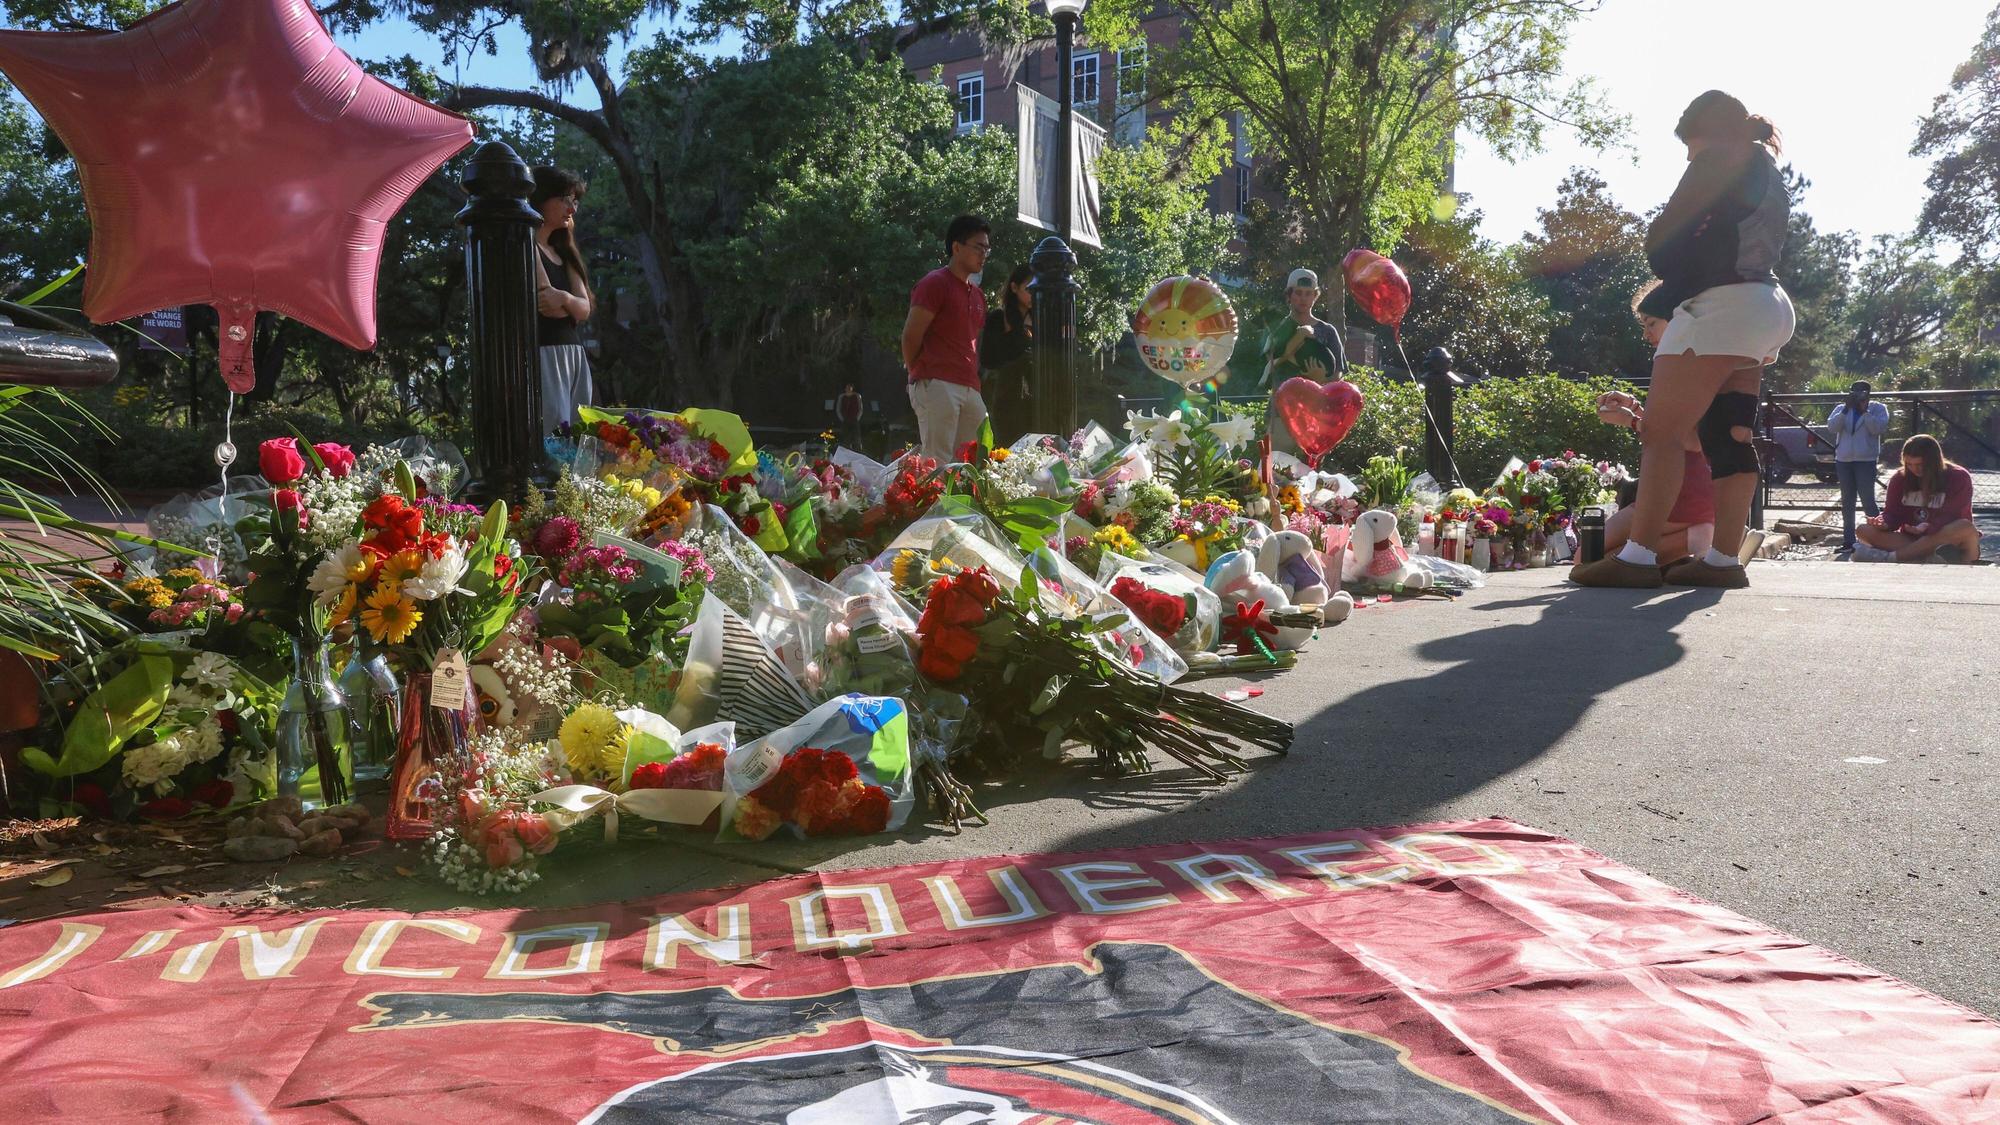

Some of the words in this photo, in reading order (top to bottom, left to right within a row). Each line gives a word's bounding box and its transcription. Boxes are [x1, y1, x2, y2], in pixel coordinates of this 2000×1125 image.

[153, 312, 182, 321] CHANGE
[143, 318, 157, 327] THE
[157, 319, 182, 329] WORLD
[1142, 344, 1166, 357] GET
